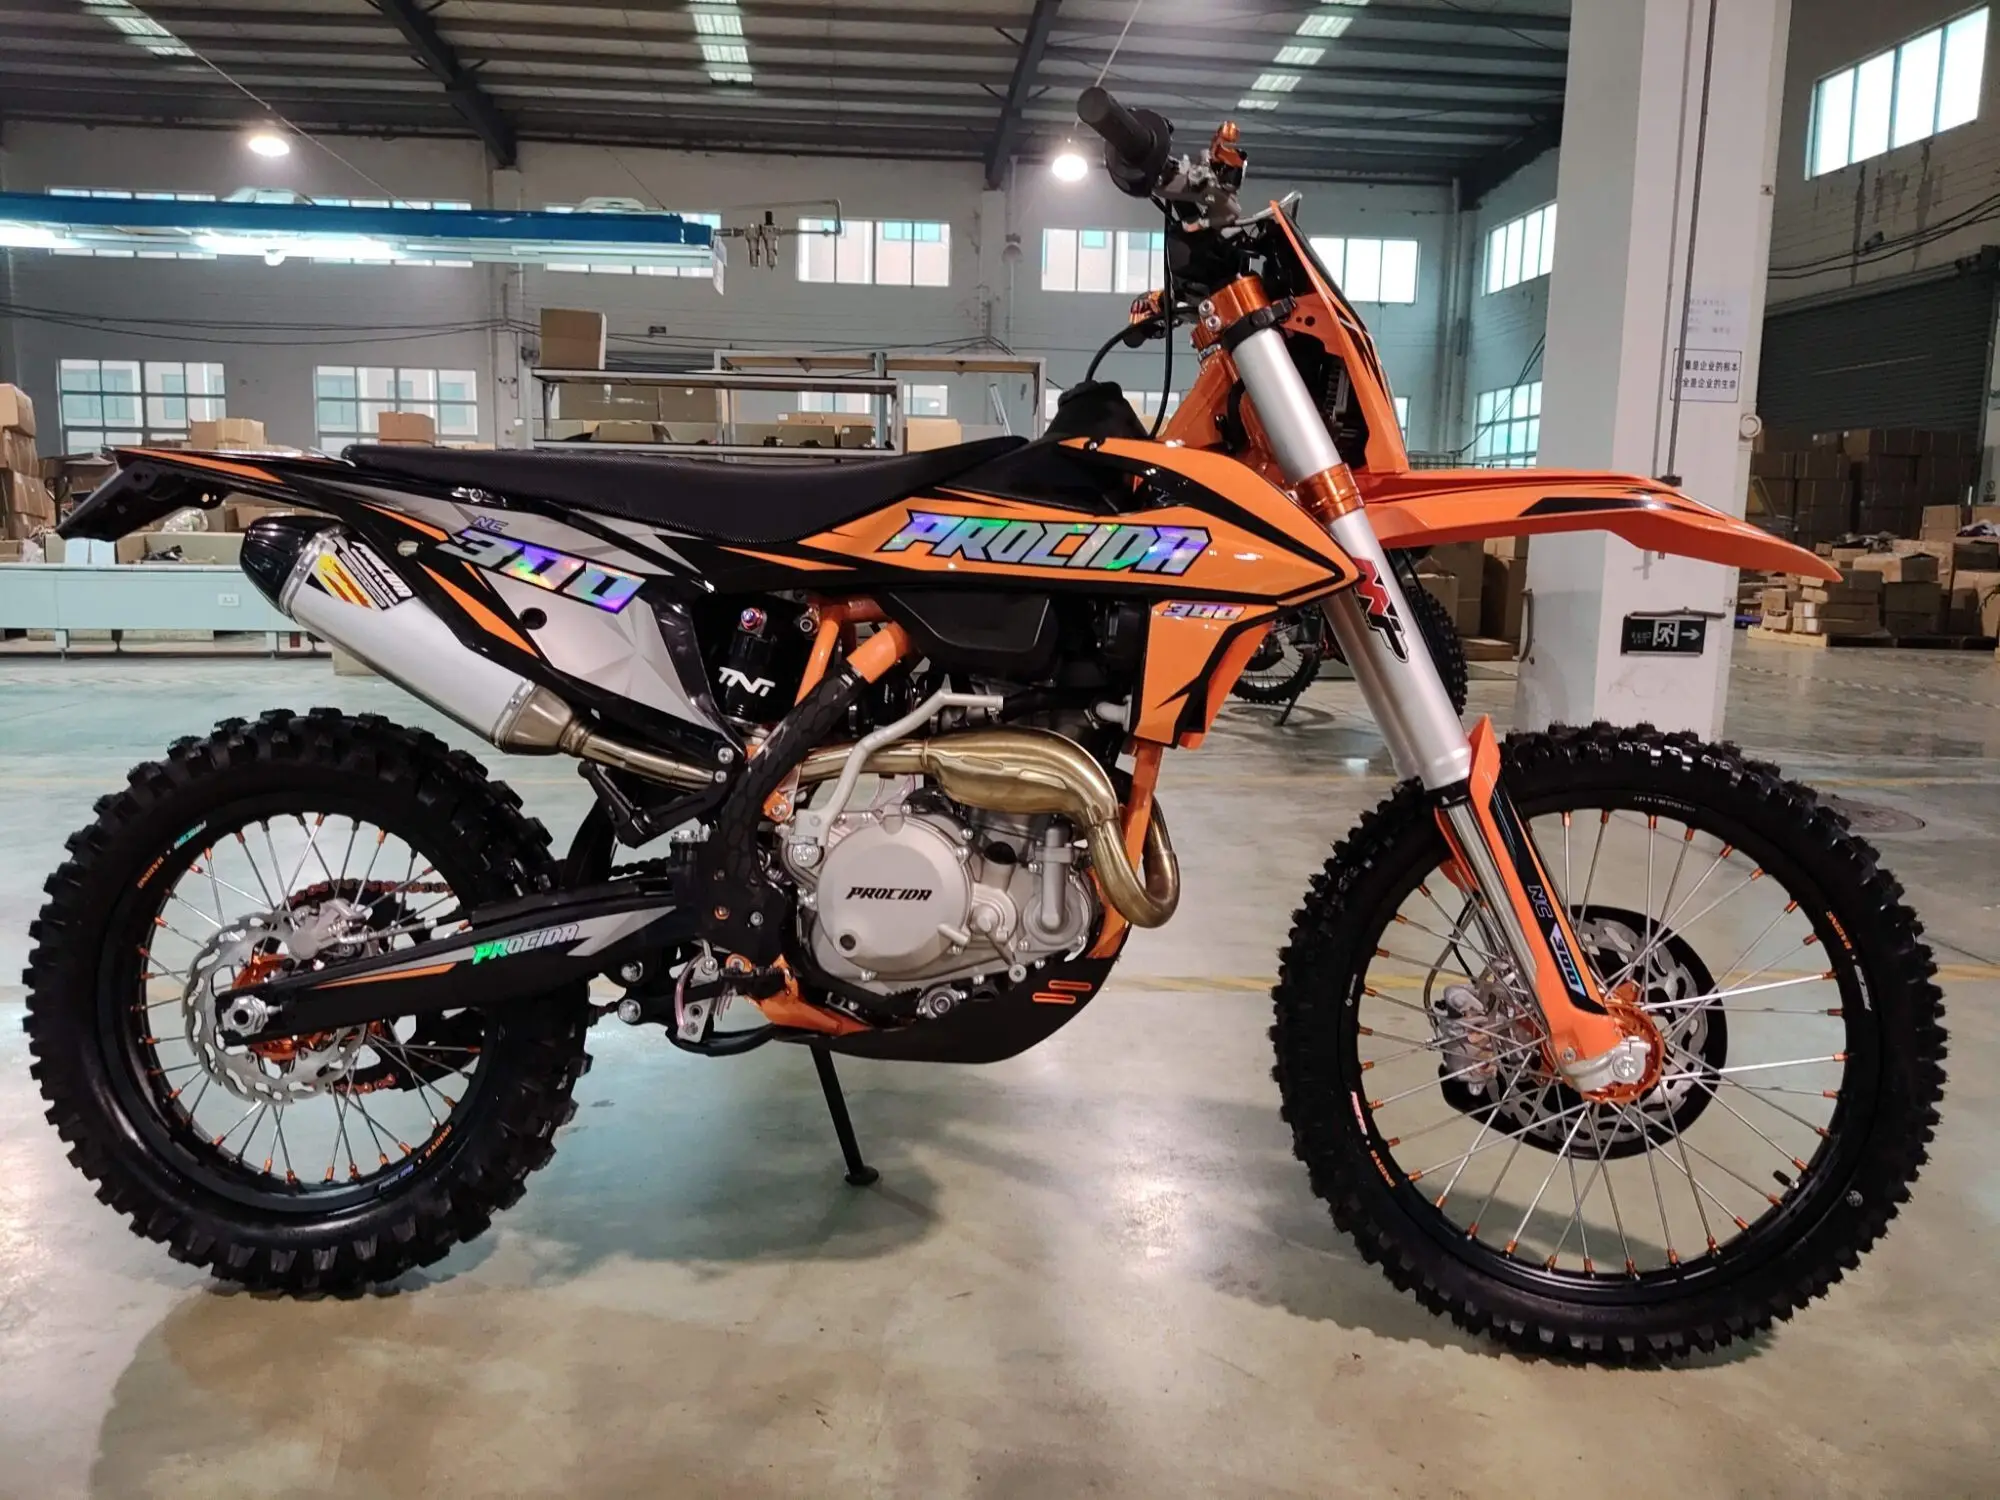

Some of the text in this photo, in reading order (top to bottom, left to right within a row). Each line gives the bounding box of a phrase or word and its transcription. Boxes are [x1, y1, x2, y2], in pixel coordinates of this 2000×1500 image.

[876, 509, 1212, 576] PROCIDA
[436, 527, 647, 615] 300
[1161, 600, 1247, 620] 300
[845, 886, 933, 901] PROCIDA
[472, 923, 580, 965] PROCIDA
